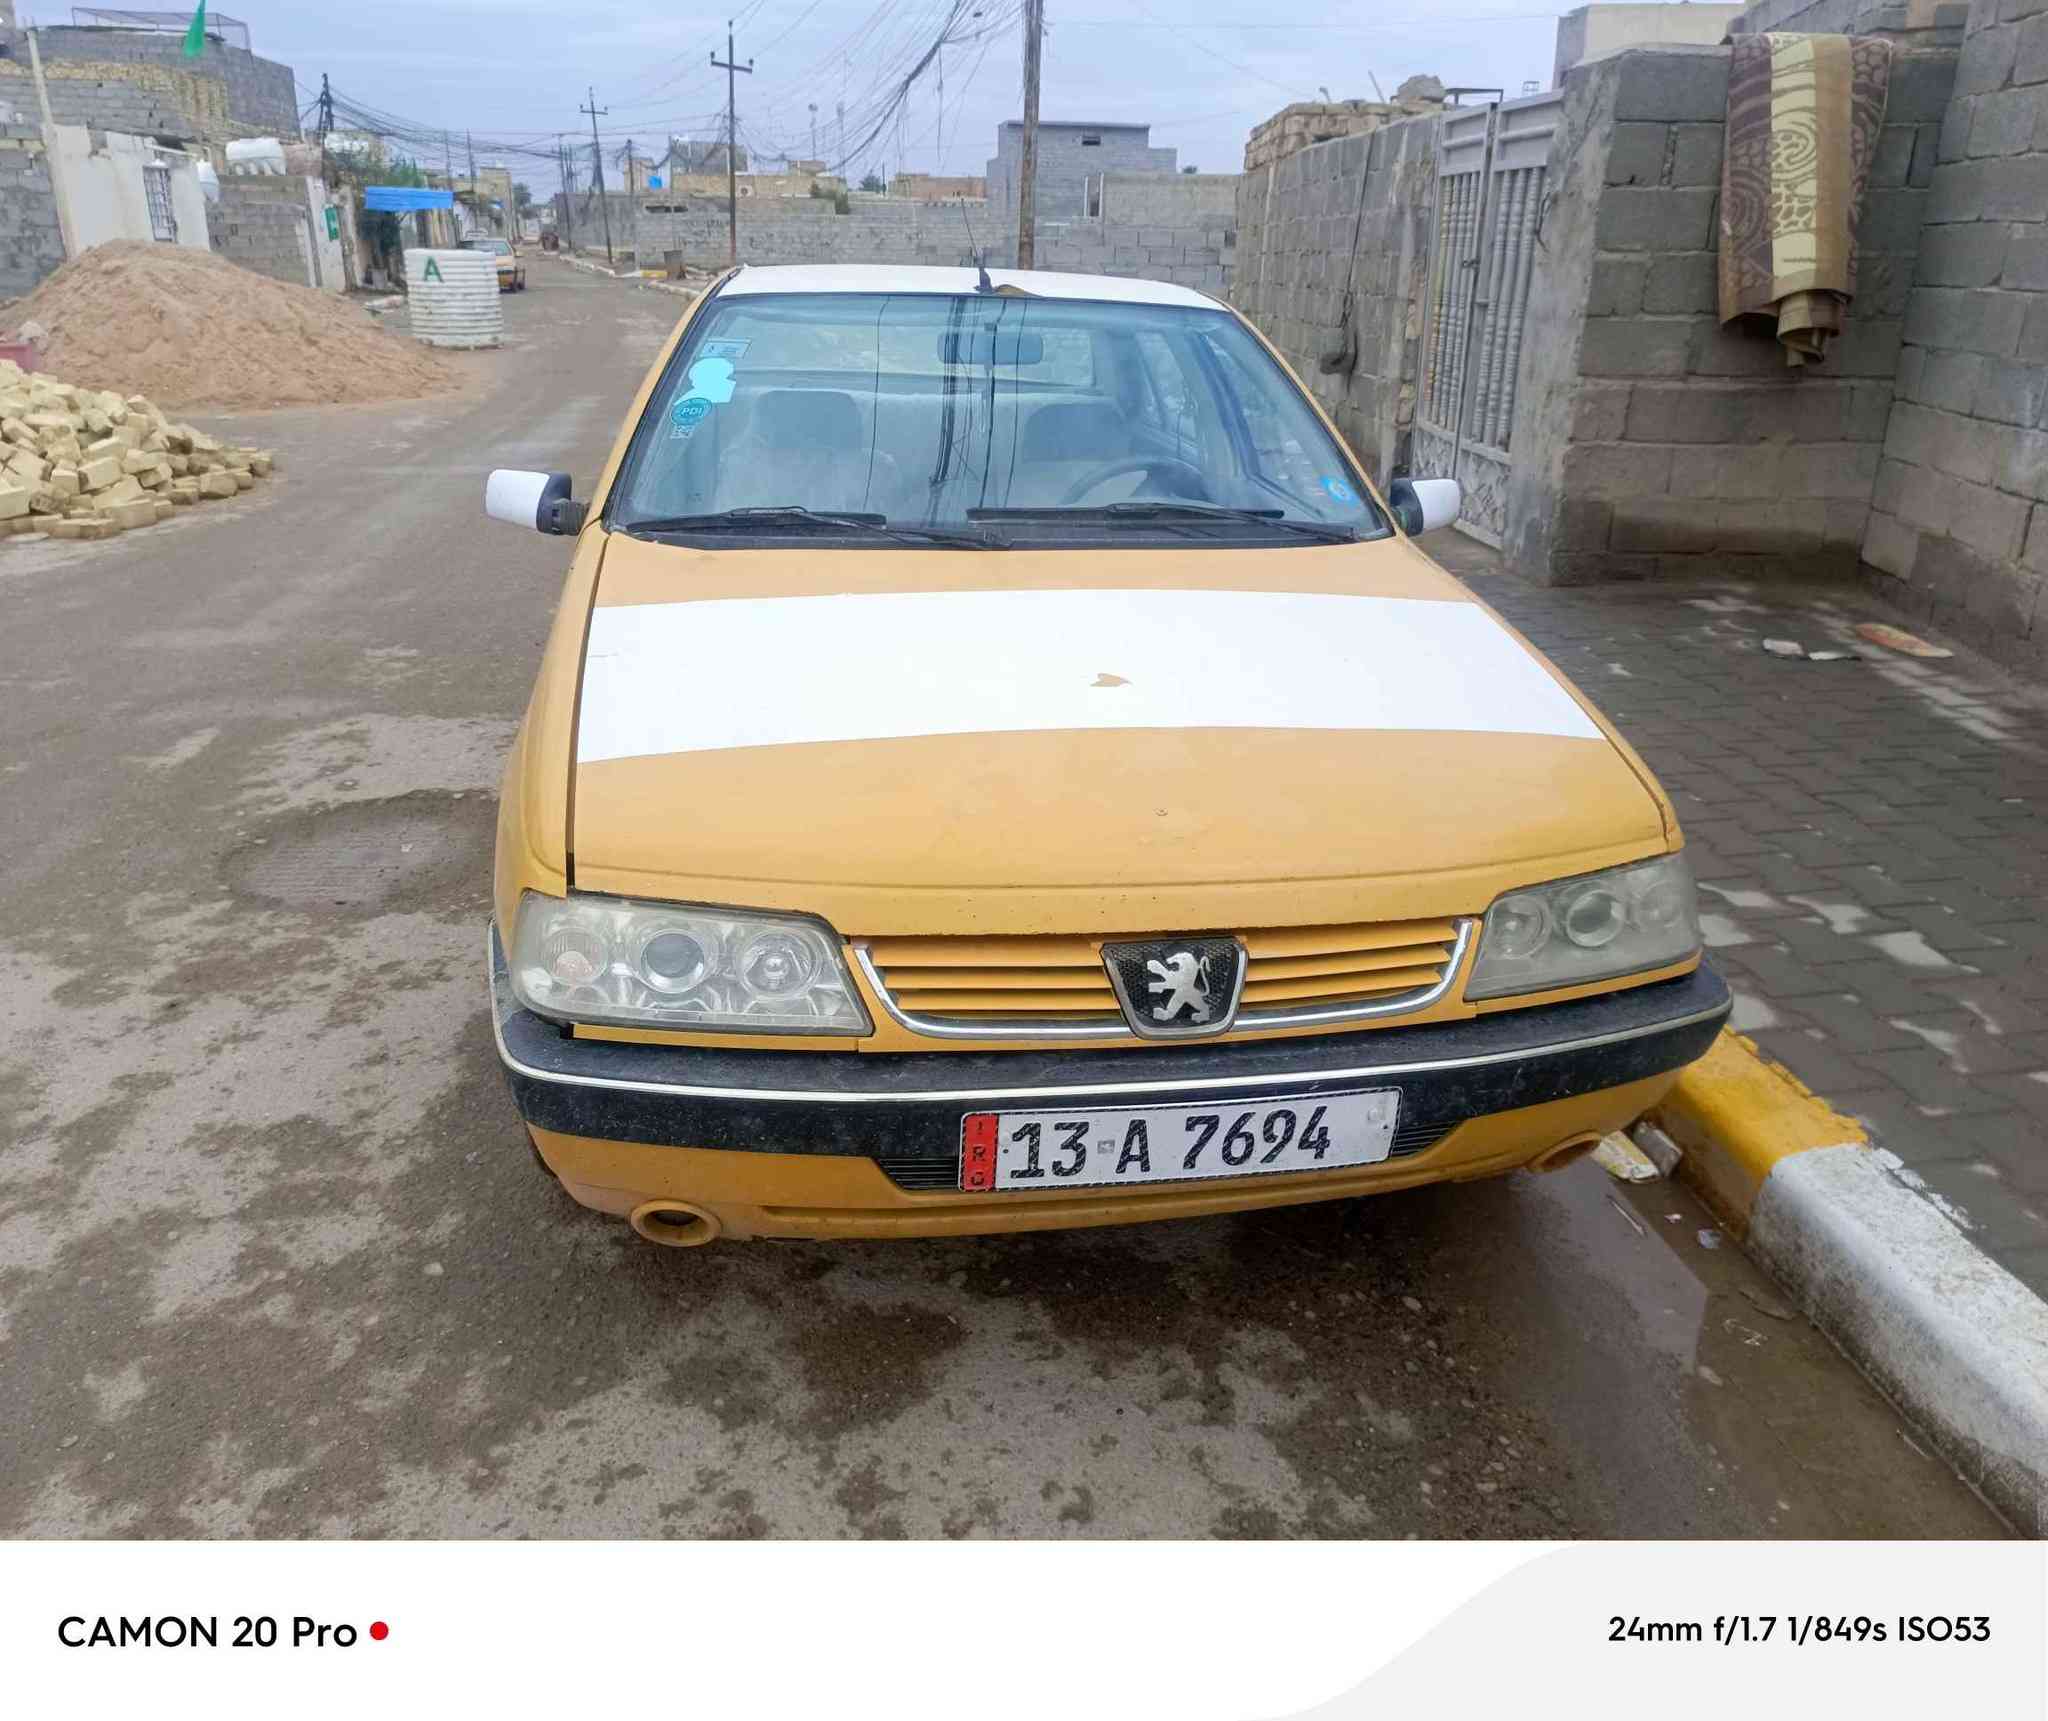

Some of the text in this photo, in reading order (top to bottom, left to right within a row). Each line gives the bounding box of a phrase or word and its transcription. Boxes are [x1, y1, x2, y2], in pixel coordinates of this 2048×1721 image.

[423, 255, 444, 283] A
[1010, 1105, 1331, 1179] 13 A 7694
